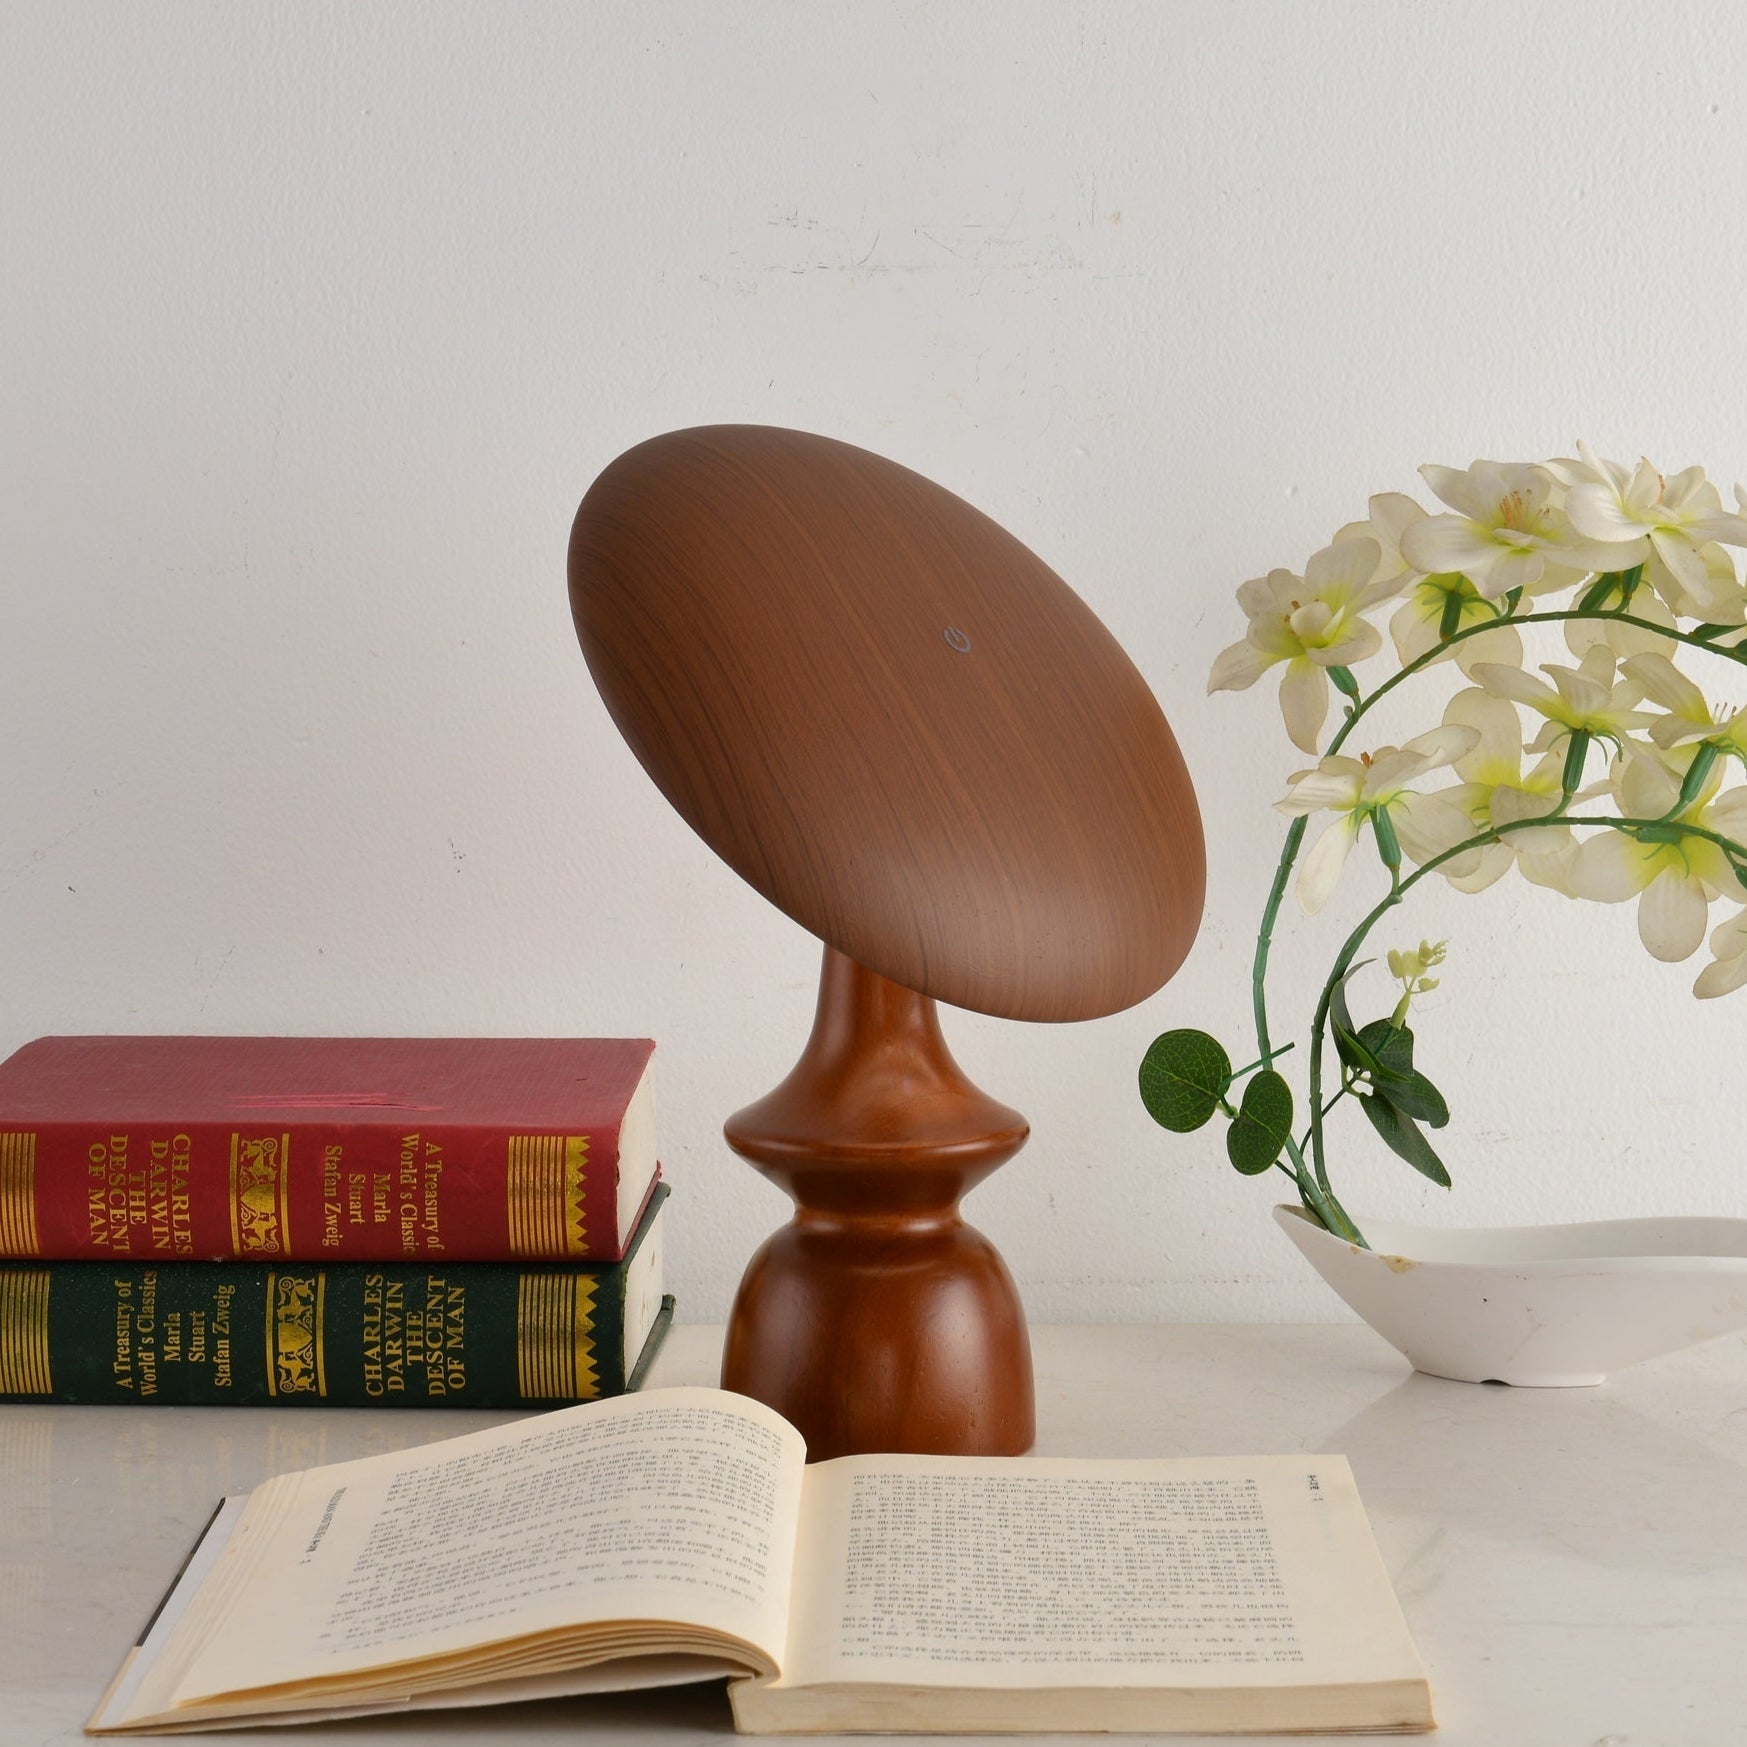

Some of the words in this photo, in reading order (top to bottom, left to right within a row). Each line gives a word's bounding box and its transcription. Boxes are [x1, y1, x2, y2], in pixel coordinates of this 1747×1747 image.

[89, 1143, 106, 1180] OF
[324, 1145, 343, 1198] Stafan
[426, 1142, 442, 1155] A
[89, 1187, 109, 1246] MAN
[109, 1134, 131, 1253] DESCENT
[129, 1170, 147, 1225] THE
[150, 1140, 171, 1250] DARWIN
[172, 1133, 193, 1254] CHARLES
[349, 1173, 366, 1224] Stuart
[422, 1160, 442, 1232] Treasury
[322, 1202, 343, 1246] Zweig
[426, 1236, 445, 1250] of
[114, 1280, 132, 1298] of
[136, 1270, 157, 1333] Classics
[212, 1284, 236, 1335] Zweig
[114, 1302, 135, 1374] Treasury
[188, 1311, 206, 1362] Stuart
[363, 1273, 384, 1397] CHARLES
[385, 1281, 405, 1392] DARWIN
[406, 1310, 424, 1366] THE
[425, 1275, 447, 1396] DESCENT
[446, 1286, 465, 1350] MAN
[116, 1377, 133, 1389] A
[213, 1339, 232, 1387] Stafan
[447, 1357, 466, 1390] OF
